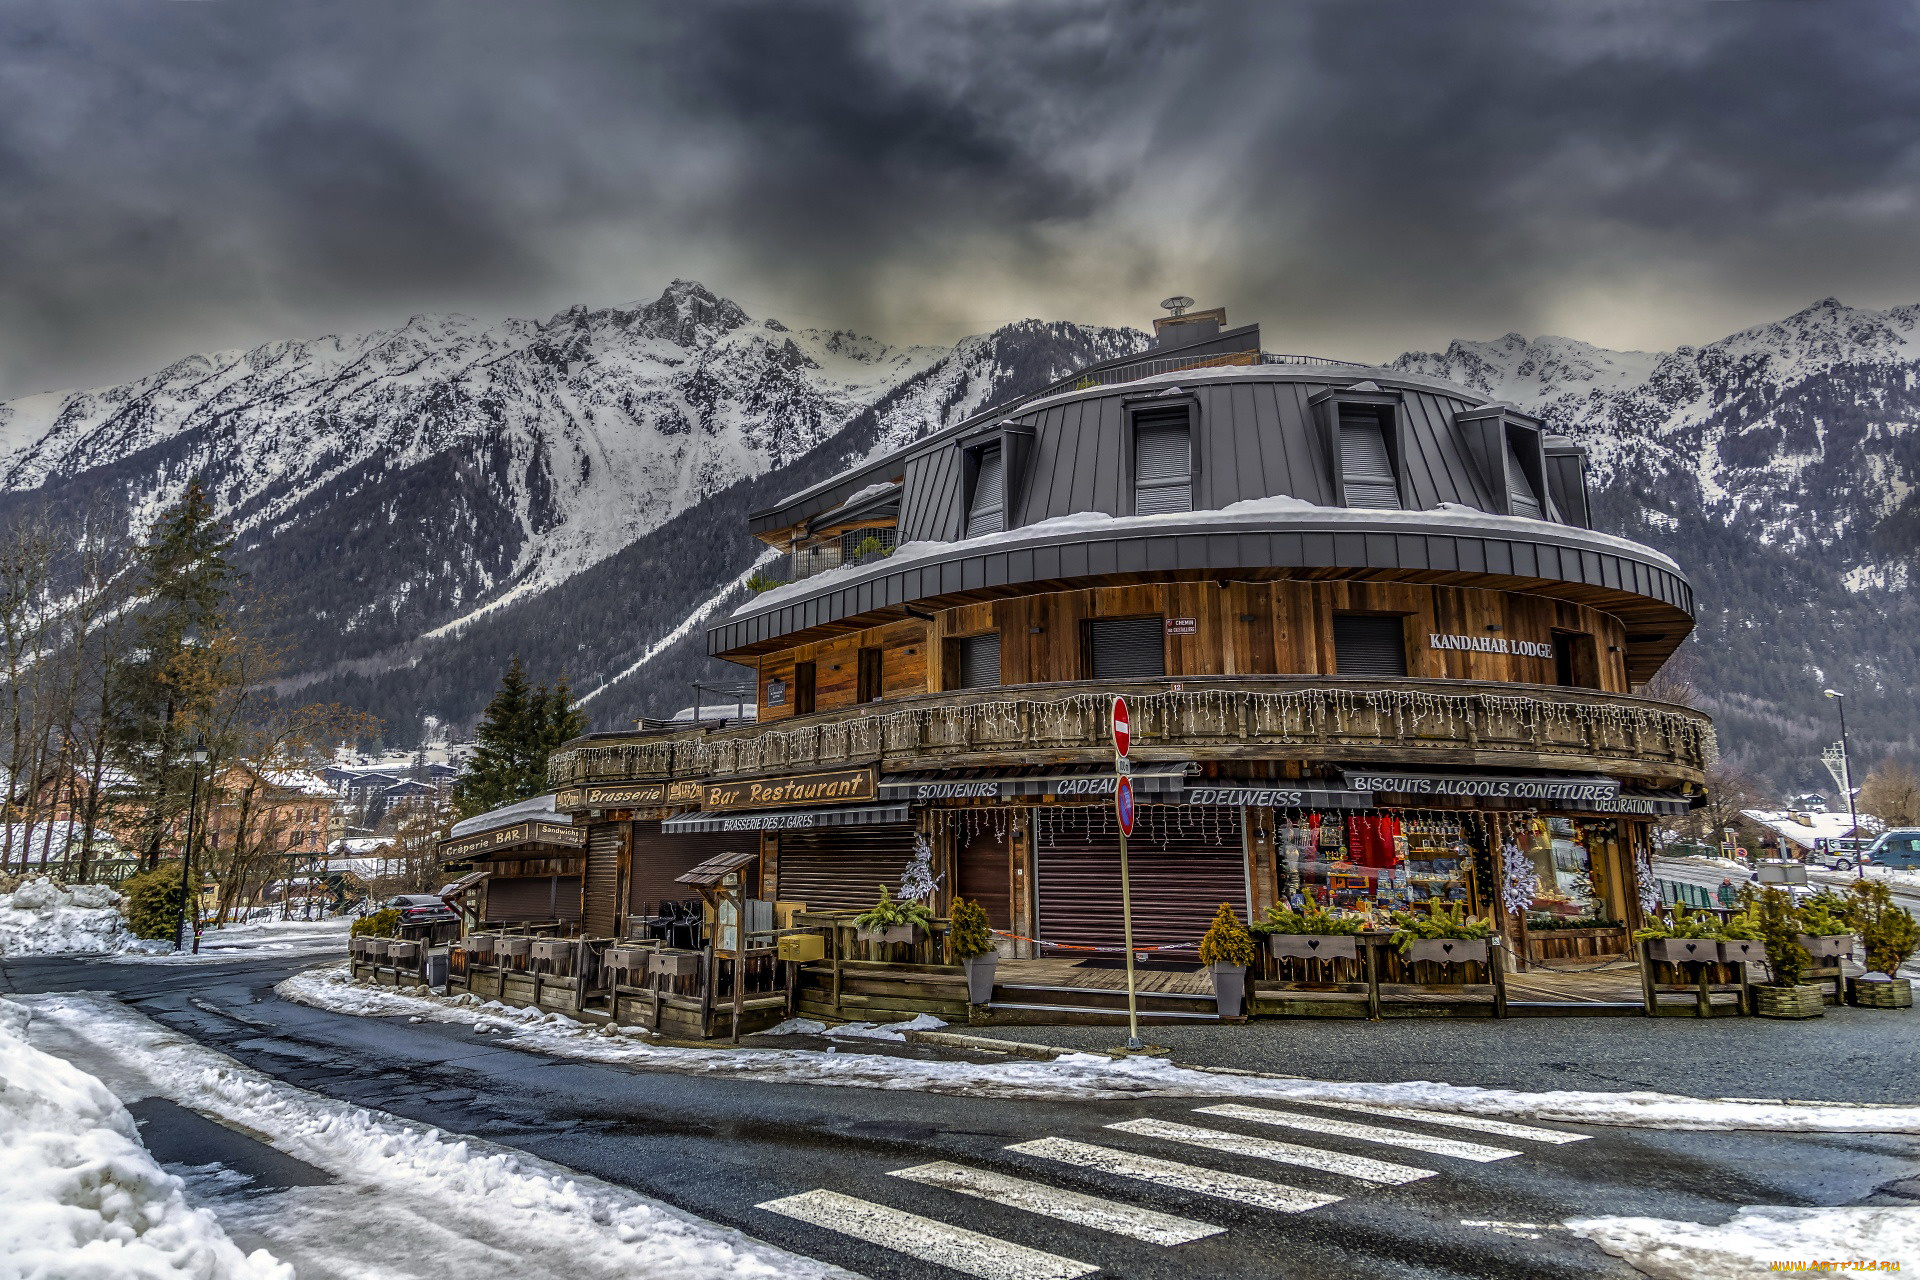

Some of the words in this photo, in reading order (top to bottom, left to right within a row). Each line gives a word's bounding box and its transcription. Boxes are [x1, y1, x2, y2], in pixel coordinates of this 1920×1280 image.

[1429, 633, 1509, 654] KANDAHAR
[1510, 639, 1553, 659] LODGE
[1173, 684, 1181, 692] 12
[589, 788, 661, 803] Brasserie
[709, 787, 740, 806] Bar
[750, 773, 864, 802] Restaurant
[917, 782, 998, 800] SOUVENIRS
[1057, 778, 1133, 795] CADEAU
[1353, 777, 1431, 794] BISCUITS
[1435, 779, 1510, 797] ALCOOLS
[1513, 782, 1615, 801] CONFITURES
[1189, 789, 1302, 807] EDELWEISS
[723, 816, 761, 832] BRASSERIE
[761, 816, 778, 830] DES
[778, 815, 786, 829] 2
[786, 814, 813, 828] GARES
[446, 839, 489, 856] Crêperie
[495, 829, 521, 844] BAR
